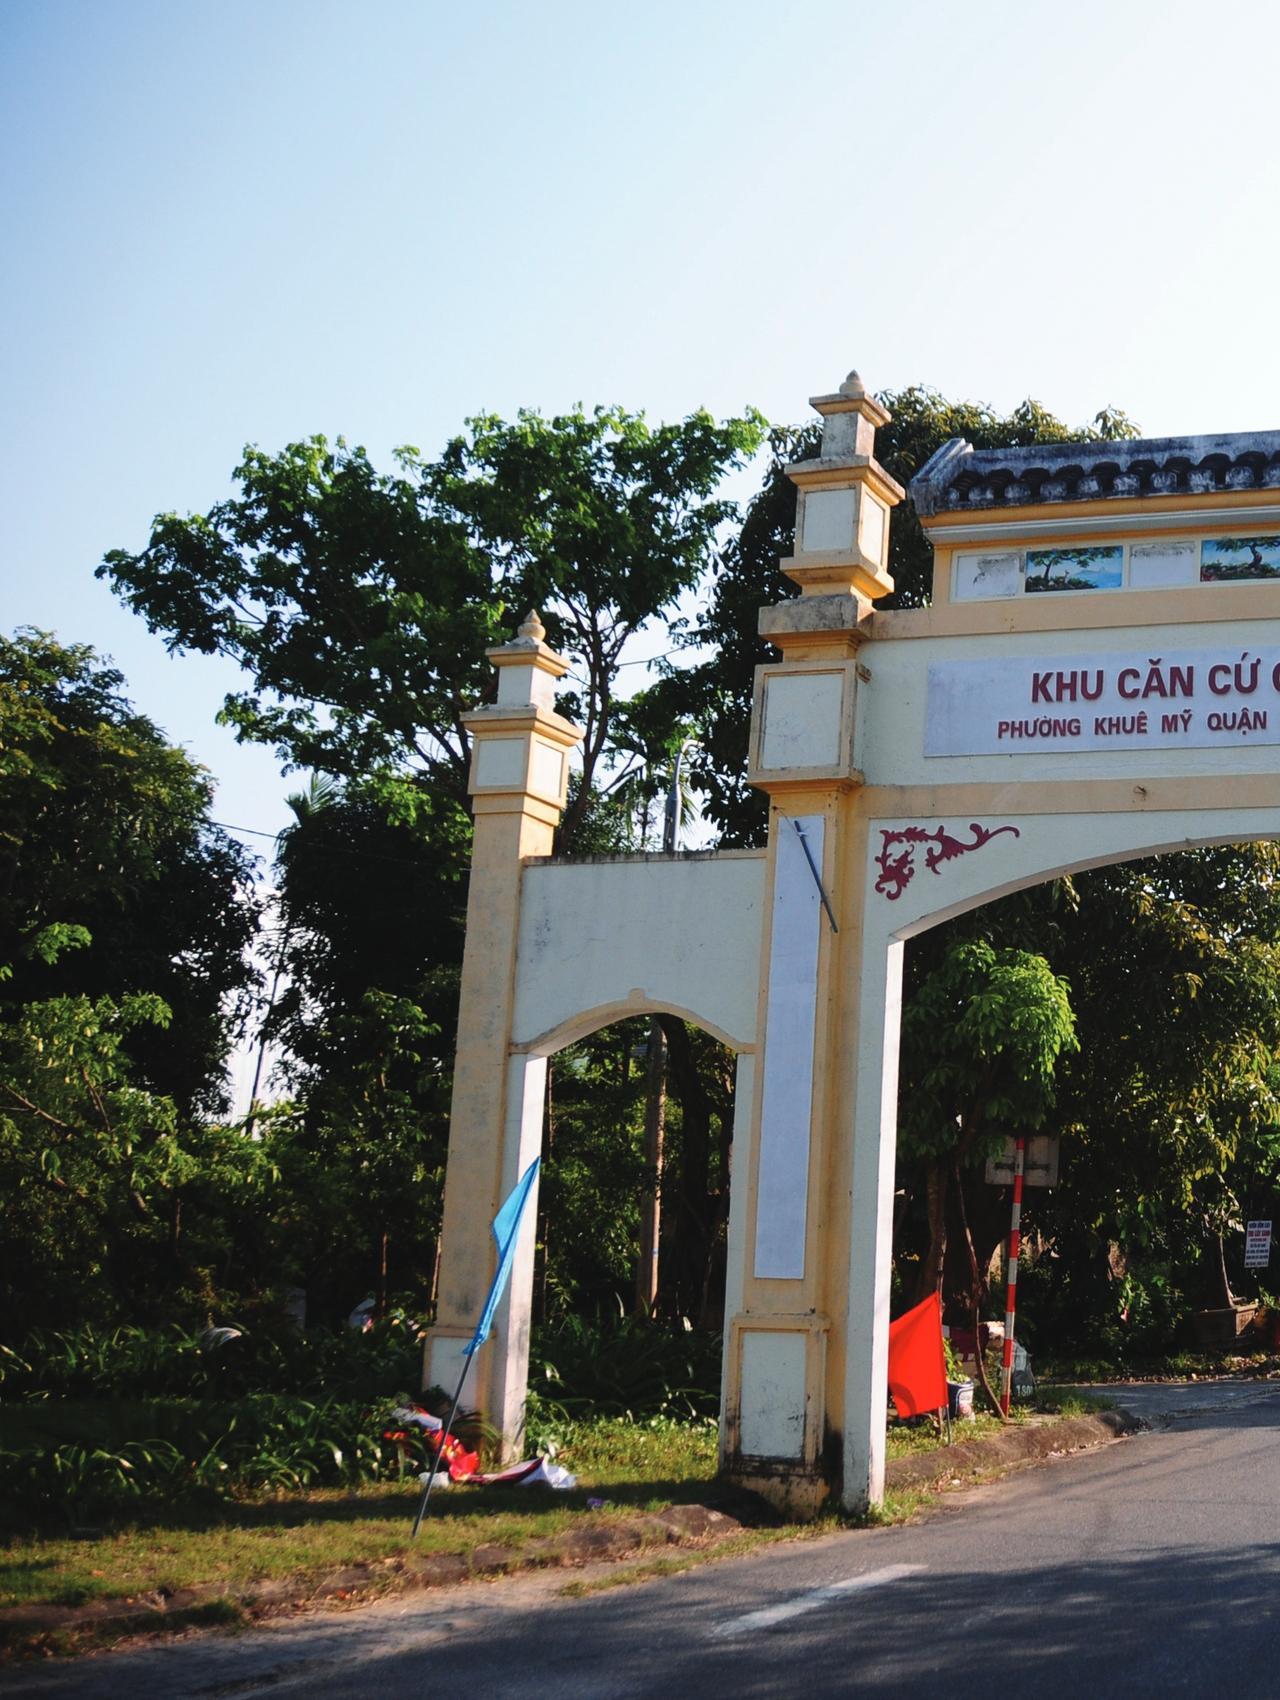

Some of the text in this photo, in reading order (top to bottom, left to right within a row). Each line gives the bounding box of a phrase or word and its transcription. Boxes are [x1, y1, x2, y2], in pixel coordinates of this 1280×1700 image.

[1031, 669, 1104, 703] KHU
[1117, 658, 1194, 699] CĂN
[1208, 652, 1262, 695] CỨ
[997, 716, 1081, 739] PHƯỜNG
[1094, 711, 1148, 736] KHUÊ
[1161, 709, 1193, 733] MỸ
[1207, 707, 1267, 736] QUẬN
